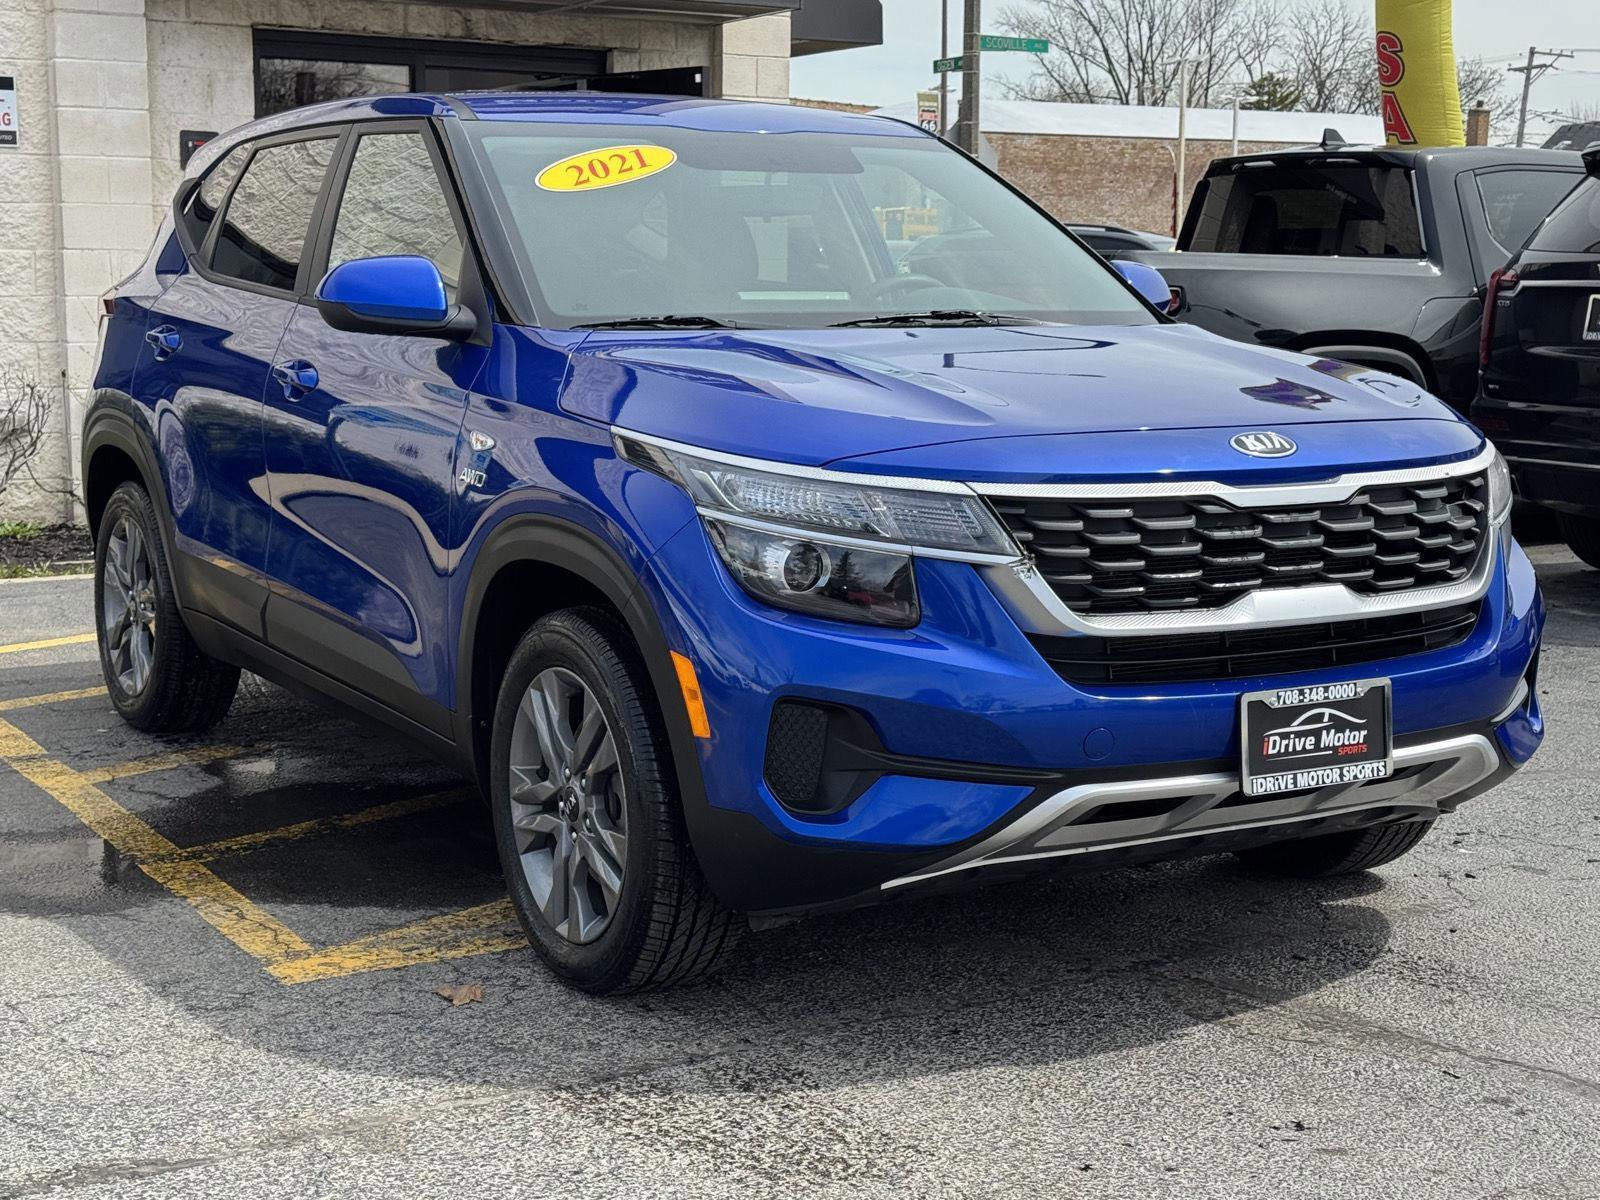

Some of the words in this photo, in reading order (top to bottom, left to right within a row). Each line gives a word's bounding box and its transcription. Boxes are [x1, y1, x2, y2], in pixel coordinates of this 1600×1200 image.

[986, 37, 1027, 50] SCOVILLE
[921, 120, 937, 132] 66
[565, 149, 653, 186] 2021
[1239, 434, 1291, 452] KIA
[459, 467, 486, 487] AWD
[1278, 683, 1355, 705] 708-348-0000
[1263, 734, 1315, 756] iDrive
[1320, 728, 1367, 748] Motor
[1338, 744, 1368, 756] SPORTS
[1297, 768, 1341, 788] MOTOR
[1342, 761, 1386, 781] SPORTS
